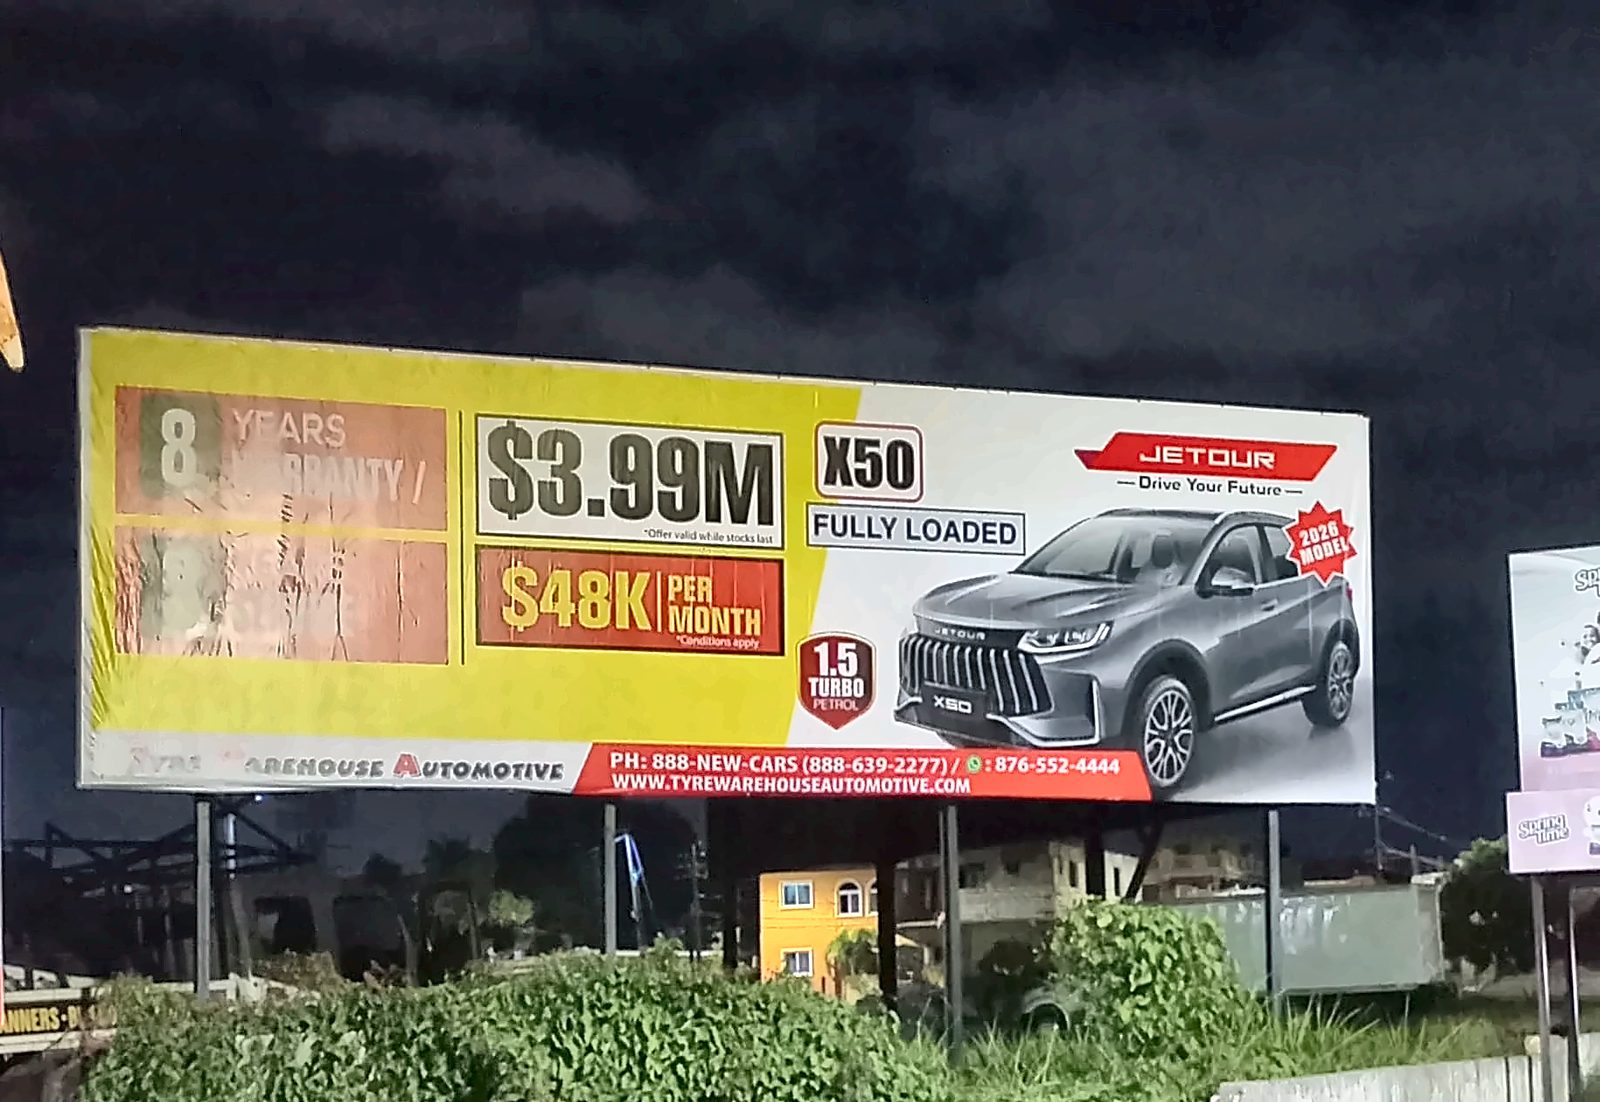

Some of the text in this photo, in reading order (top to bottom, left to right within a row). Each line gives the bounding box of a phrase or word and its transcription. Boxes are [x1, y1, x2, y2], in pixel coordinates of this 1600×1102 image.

[232, 411, 346, 448] YEARS
[162, 408, 196, 487] 8
[1139, 446, 1275, 469] JETOUR
[487, 420, 774, 525] $3.99M
[823, 436, 915, 490] X50
[1139, 476, 1282, 495] Drive Your Future
[675, 530, 697, 541] valid
[699, 531, 724, 542] while
[726, 532, 755, 543] stocks
[757, 534, 773, 544] last
[813, 514, 1017, 545] FULLY LOADED
[1300, 521, 1340, 547] 2026
[1299, 539, 1350, 566] MODEL
[501, 560, 651, 632] $48K
[668, 575, 712, 603] PER
[668, 605, 761, 636] MONTH
[733, 638, 760, 650] apply
[934, 628, 986, 641] JETOUR
[814, 642, 858, 676] 1.5
[808, 677, 864, 698] TURBO
[813, 698, 859, 711] PETROL
[610, 752, 646, 769] PH:
[652, 753, 797, 772] 888-NEW-CARS
[802, 755, 947, 776] (888-639-2277)
[995, 757, 1120, 774] 876-552-4444
[612, 774, 971, 794] WWW.TYREWAREHOUSEAUTOMOTIVE.COM
